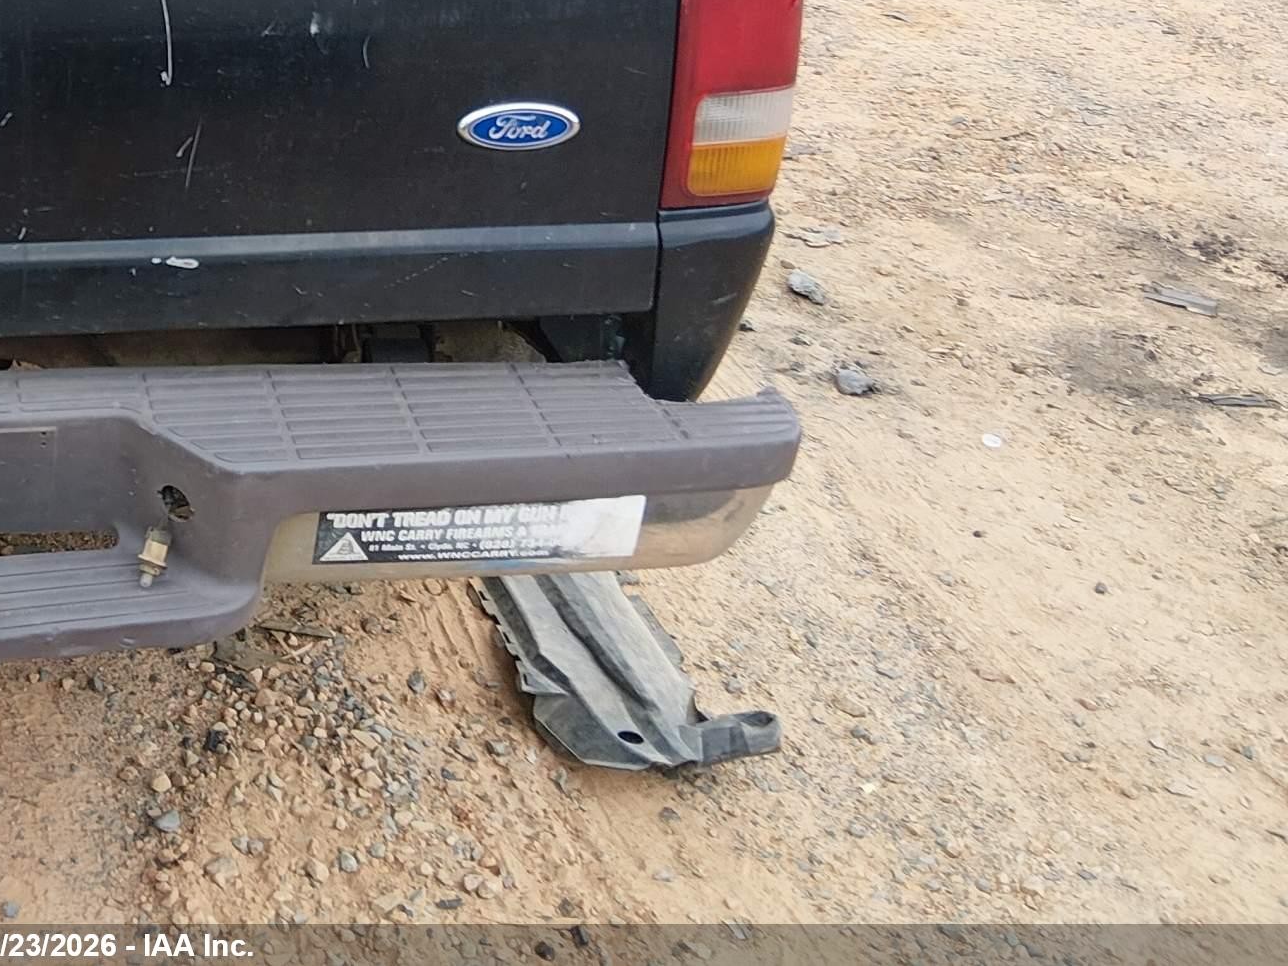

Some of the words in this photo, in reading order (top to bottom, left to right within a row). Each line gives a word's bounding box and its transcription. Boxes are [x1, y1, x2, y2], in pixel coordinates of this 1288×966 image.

[488, 114, 552, 140] Ford
[392, 510, 452, 528] TREAD
[454, 509, 481, 525] ON
[483, 507, 513, 524] MY
[361, 530, 395, 542] WNC
[398, 528, 443, 542] CARRY
[445, 525, 513, 541] FIREARMS
